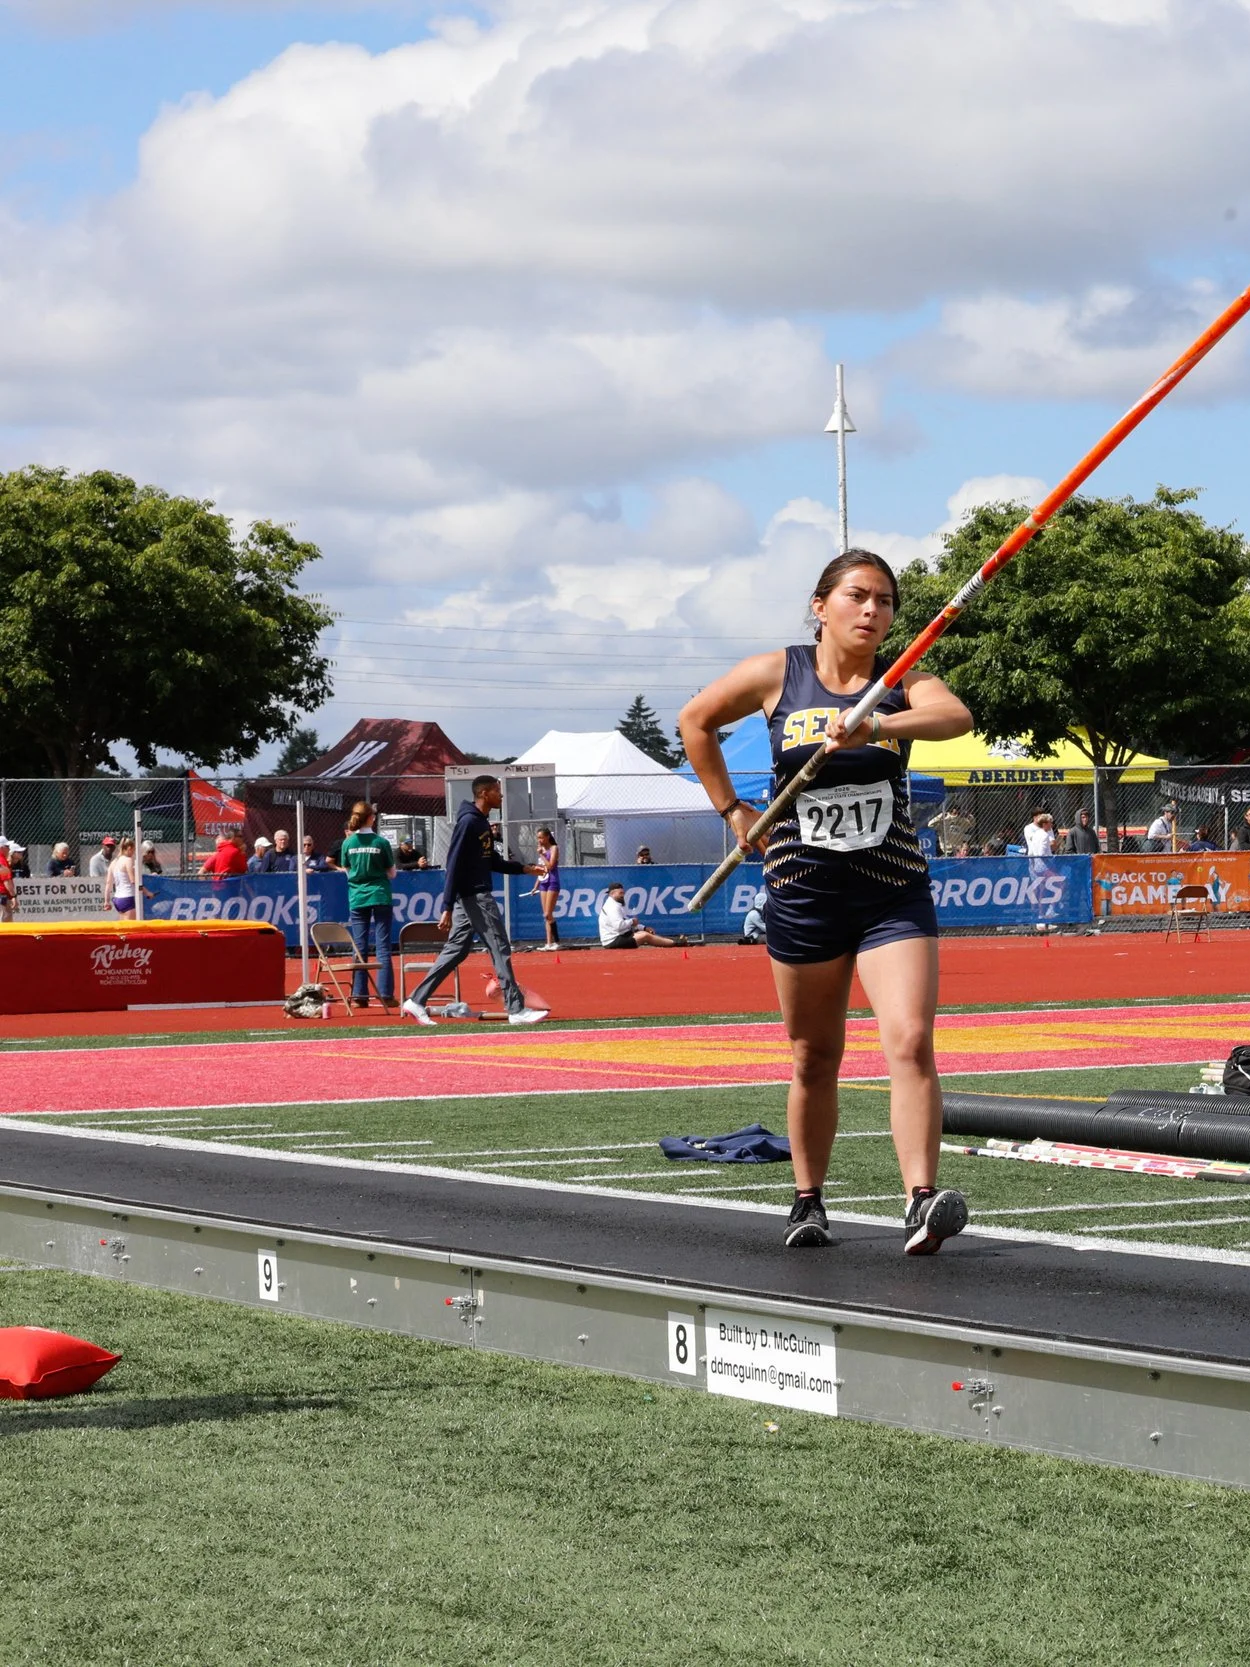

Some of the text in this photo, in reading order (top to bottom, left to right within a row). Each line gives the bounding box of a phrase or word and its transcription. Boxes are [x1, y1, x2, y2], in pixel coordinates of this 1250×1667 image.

[967, 769, 1065, 784] ABERDEEN
[807, 798, 882, 842] 2217
[16, 884, 102, 896] BEST FOR YOUR
[1111, 872, 1167, 884] BACK TO
[91, 944, 153, 970] Richey
[262, 1258, 272, 1292] 9
[675, 1324, 688, 1365] 8
[719, 1323, 821, 1357] Built by D. McGuinn
[710, 1357, 833, 1395] ddmcguinn@gmail.com
